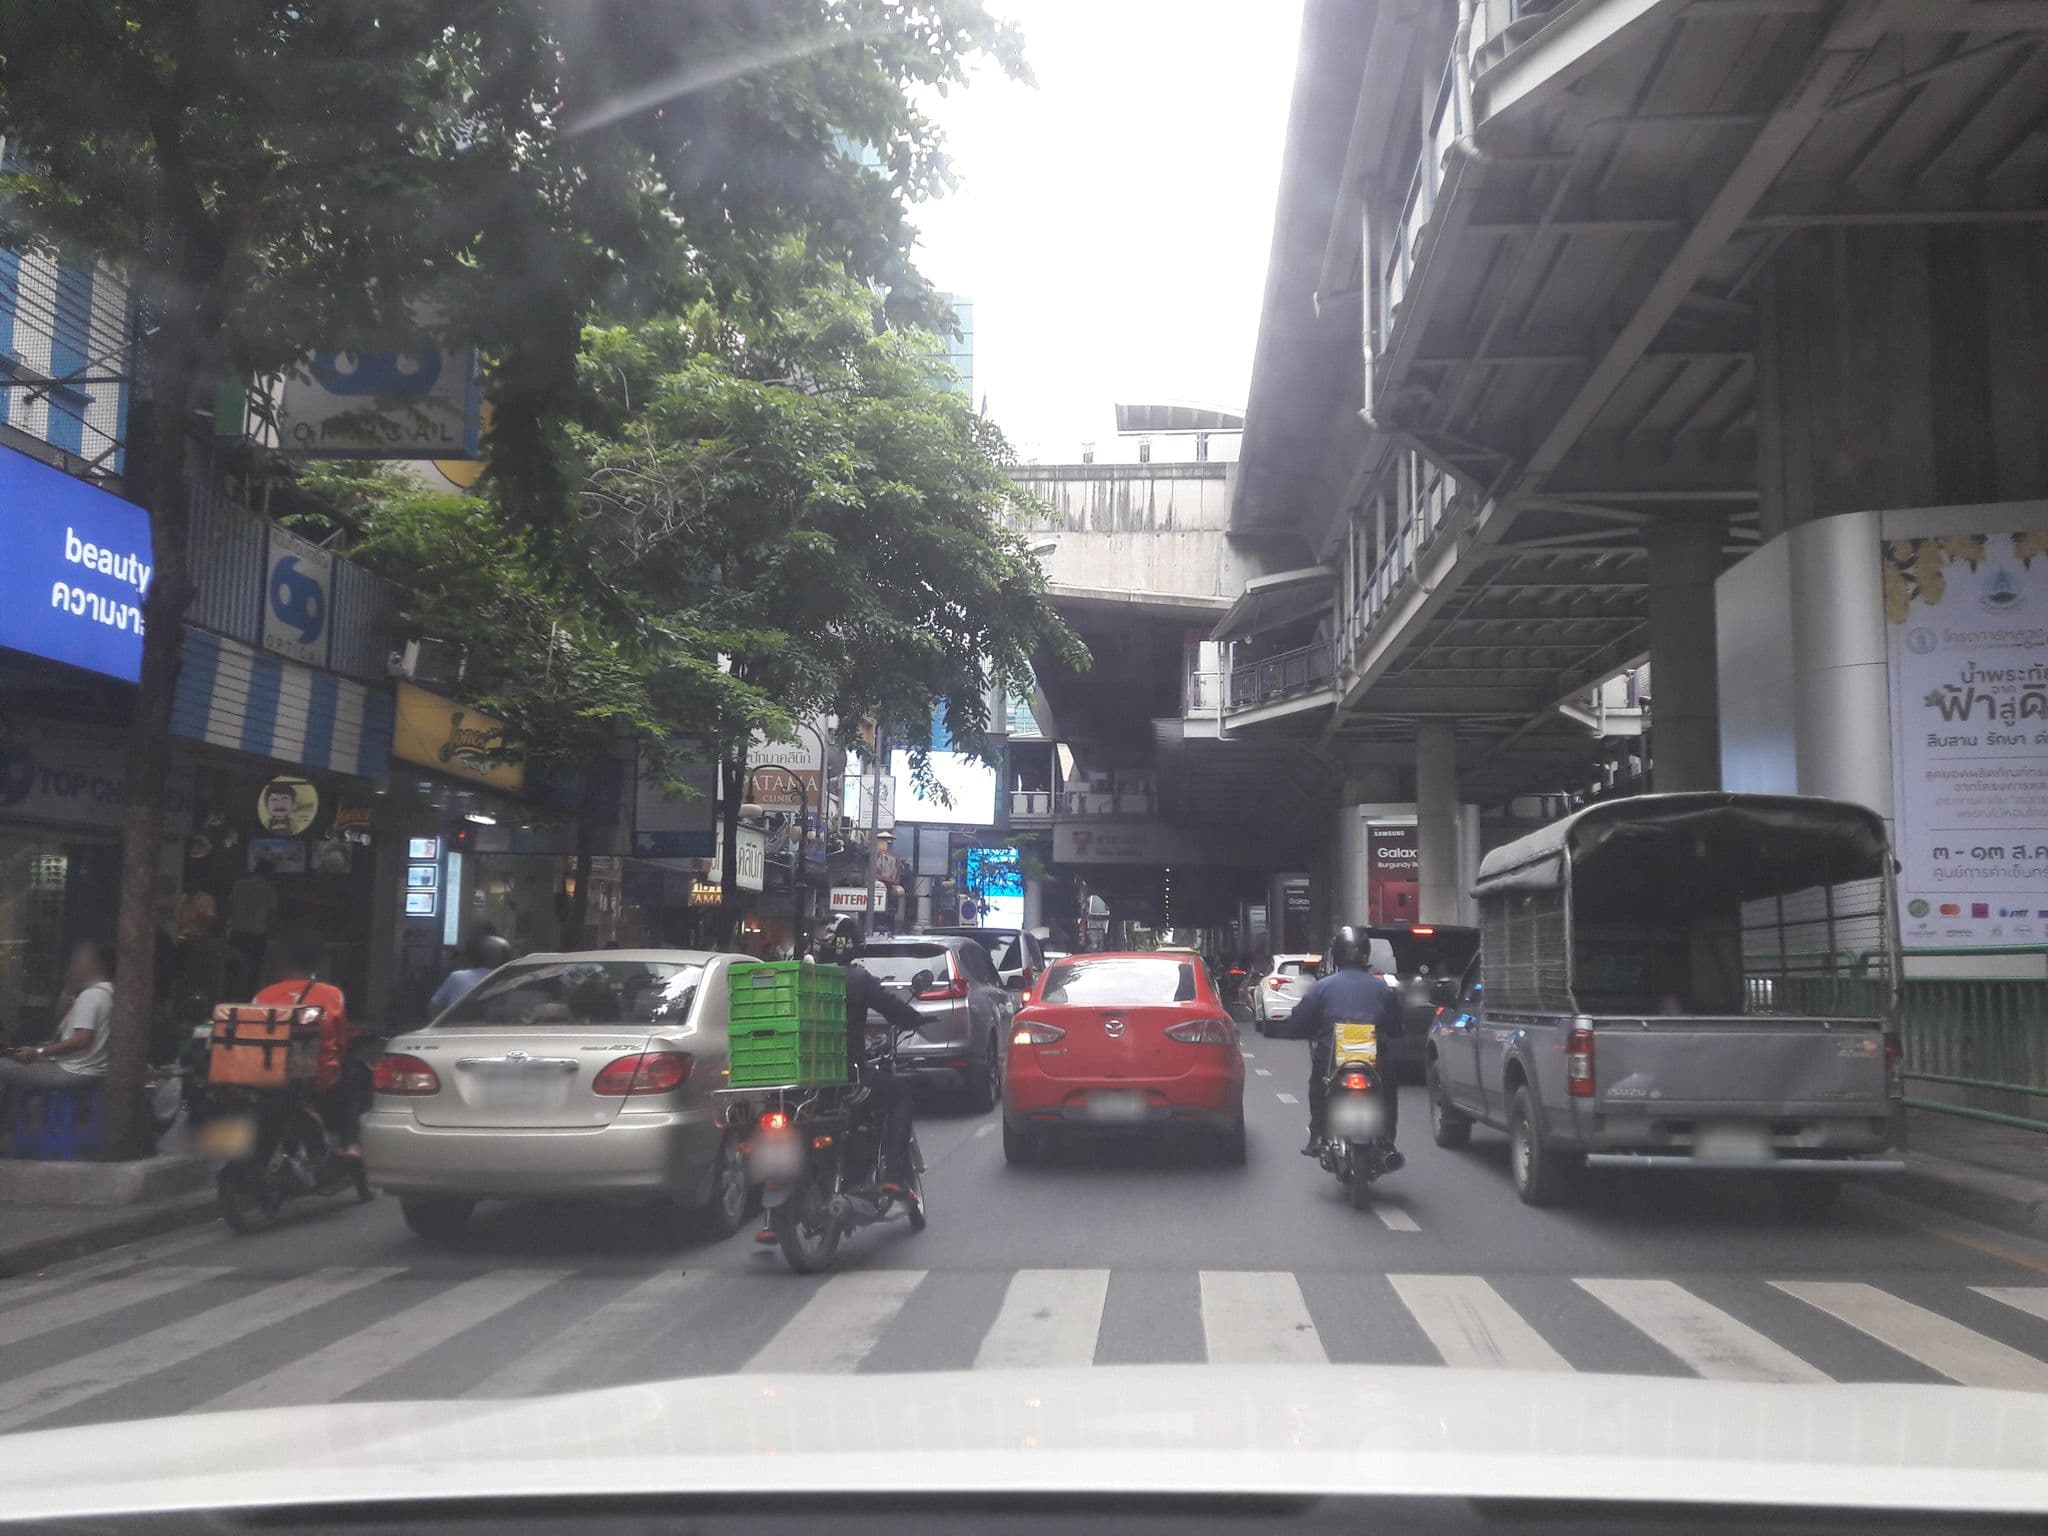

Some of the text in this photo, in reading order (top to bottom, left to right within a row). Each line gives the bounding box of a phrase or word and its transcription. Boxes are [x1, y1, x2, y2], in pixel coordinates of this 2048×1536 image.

[65, 526, 150, 594] beauty
[1377, 847, 1419, 858] Galax
[832, 893, 884, 906] INTERNT
